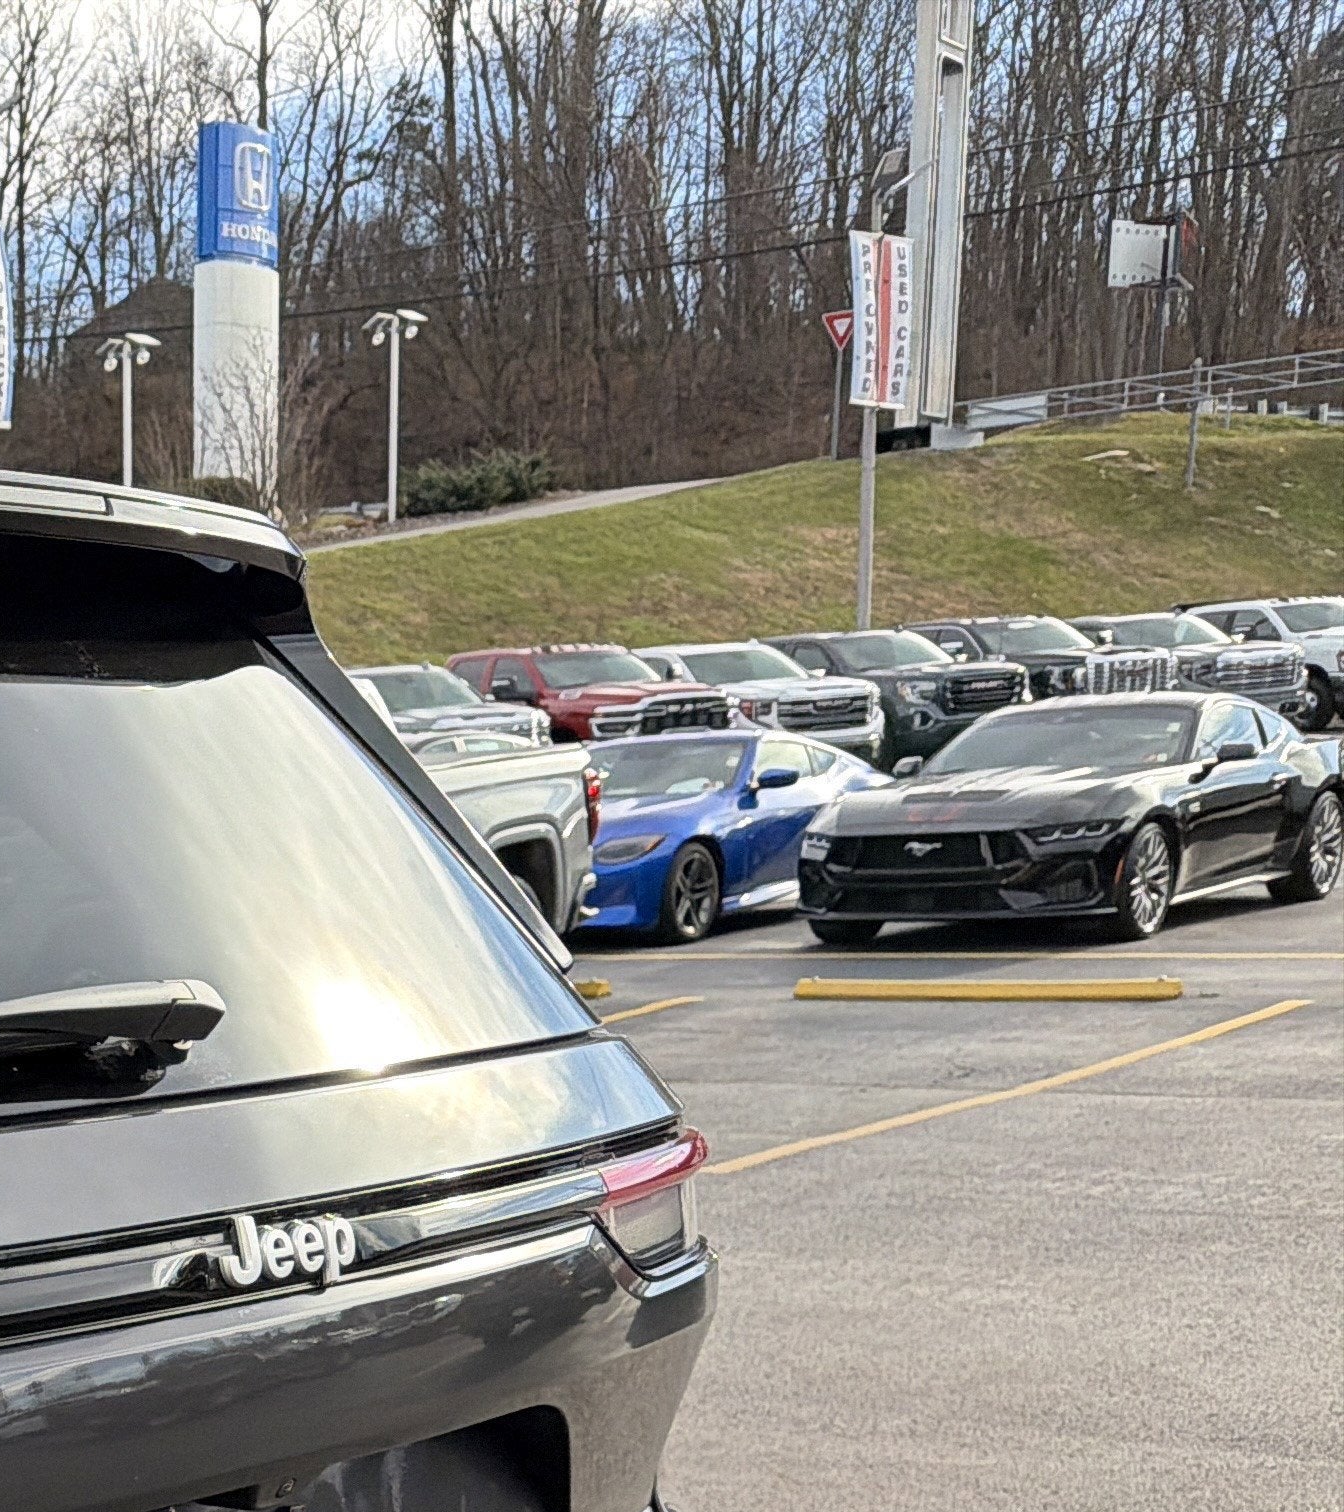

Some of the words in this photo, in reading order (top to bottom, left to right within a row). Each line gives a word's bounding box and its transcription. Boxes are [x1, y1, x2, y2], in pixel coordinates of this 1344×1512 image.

[896, 246, 909, 315] USED
[890, 325, 908, 397] CARS
[218, 1214, 356, 1286] Jeep
